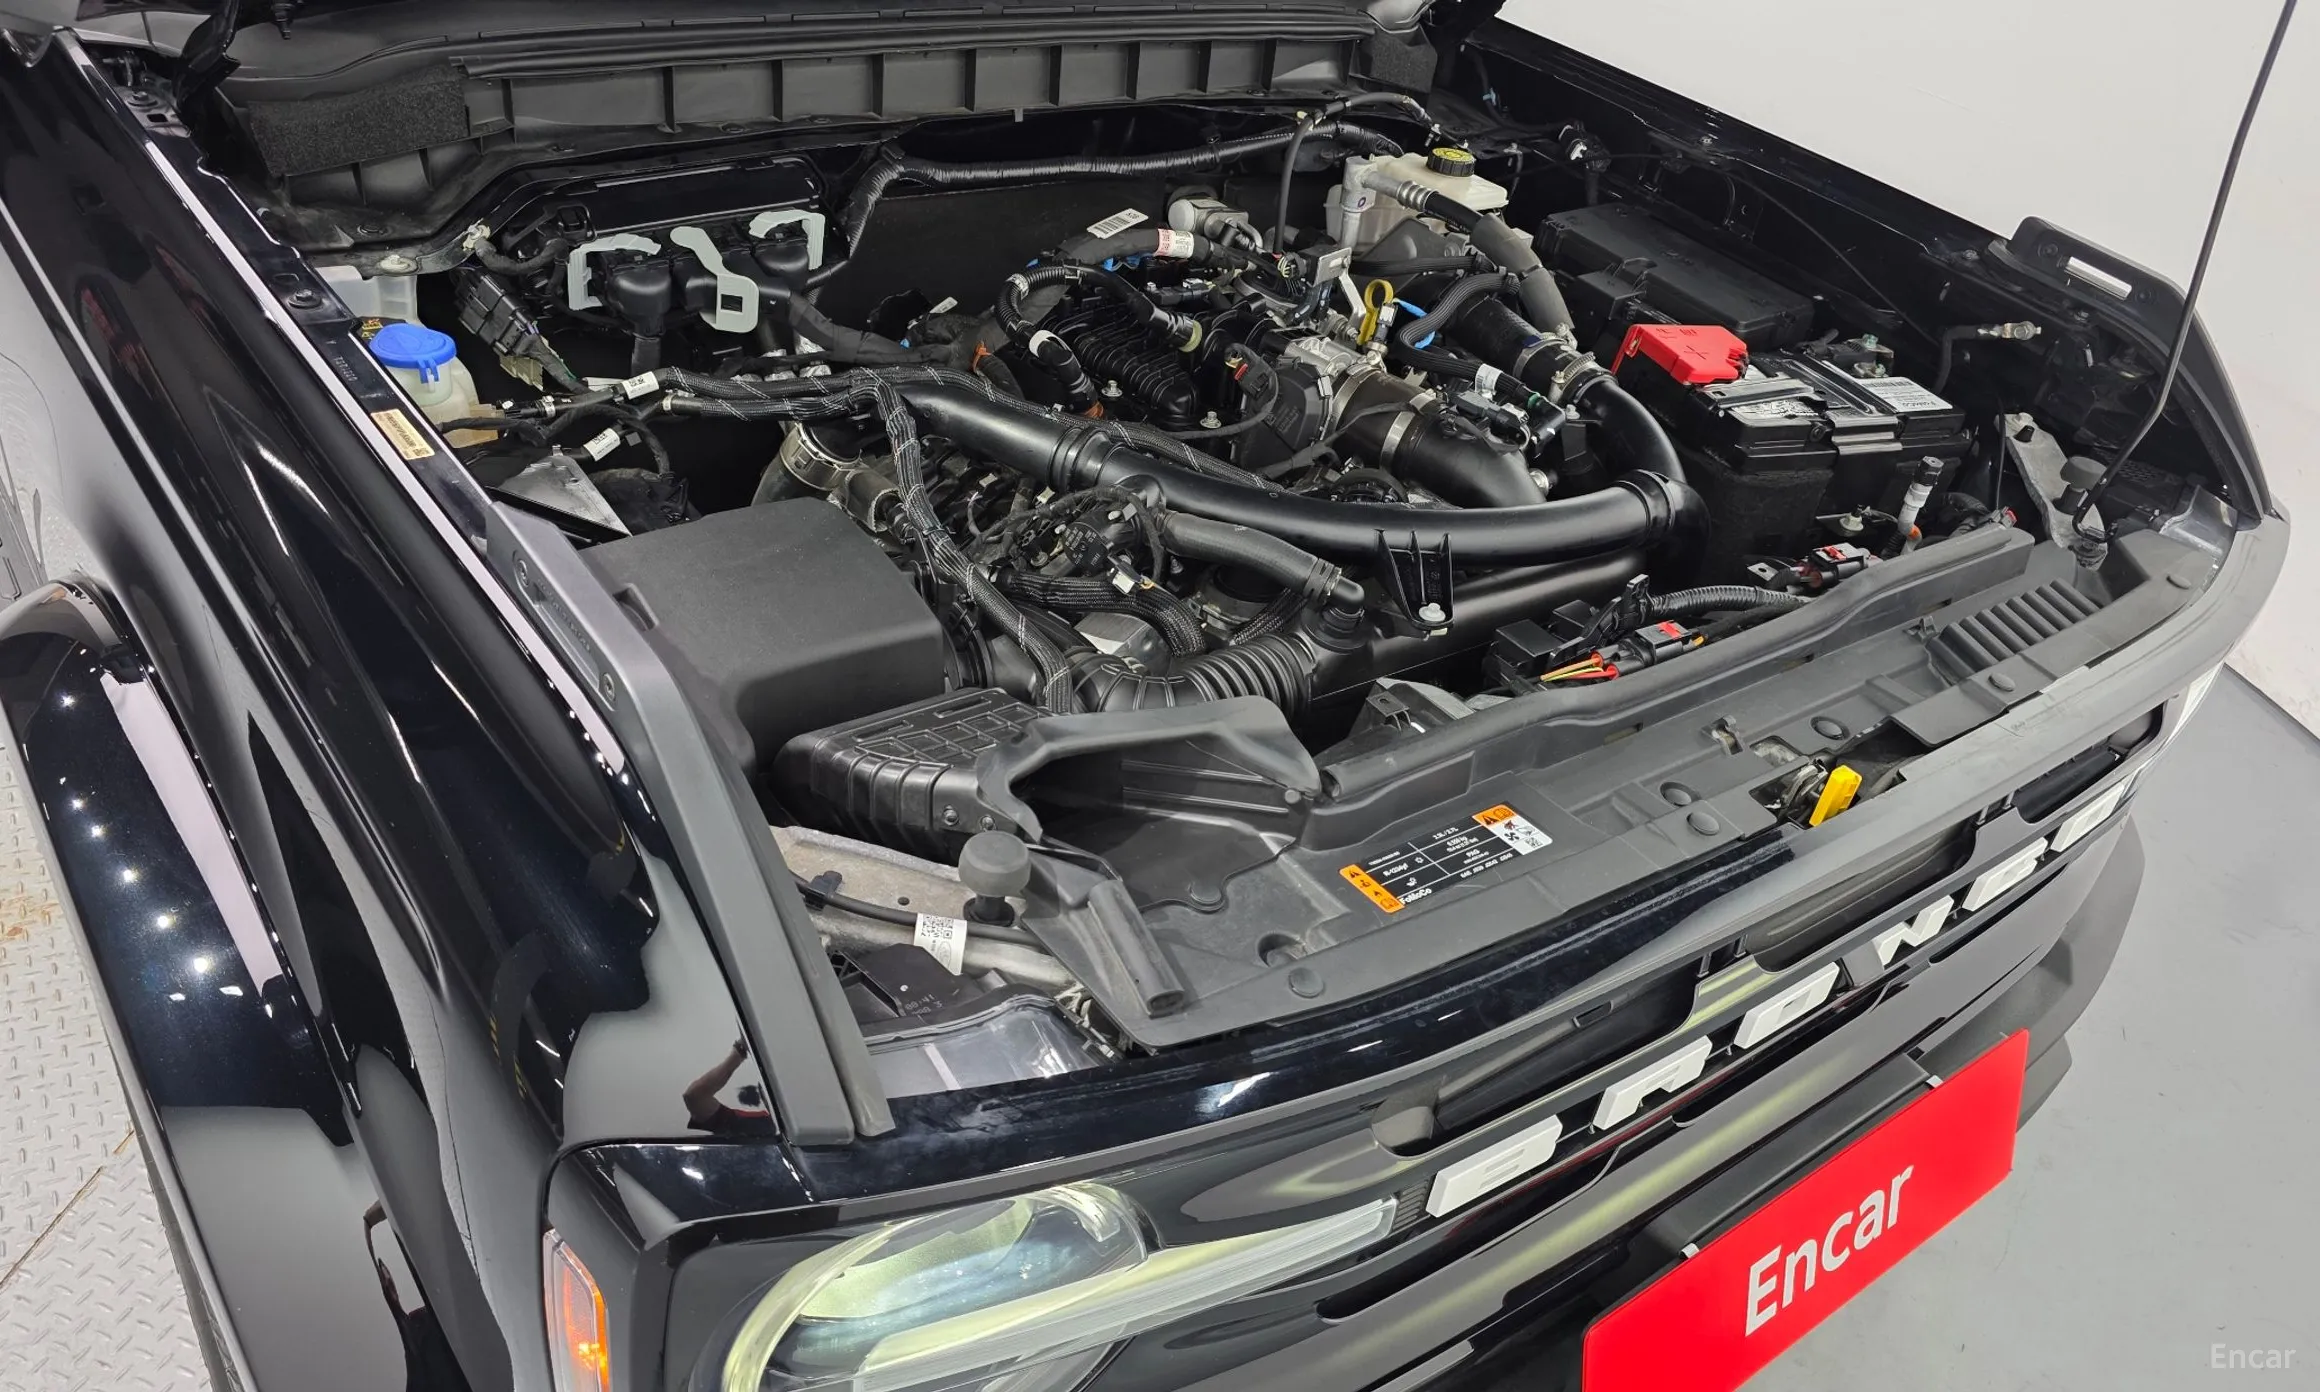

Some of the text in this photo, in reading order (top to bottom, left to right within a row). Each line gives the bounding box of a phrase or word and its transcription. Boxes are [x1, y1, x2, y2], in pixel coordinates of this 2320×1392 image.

[1399, 888, 1432, 904] FoMoCo
[1426, 783, 2125, 1218] BRONCO
[1745, 1164, 1915, 1337] Encar
